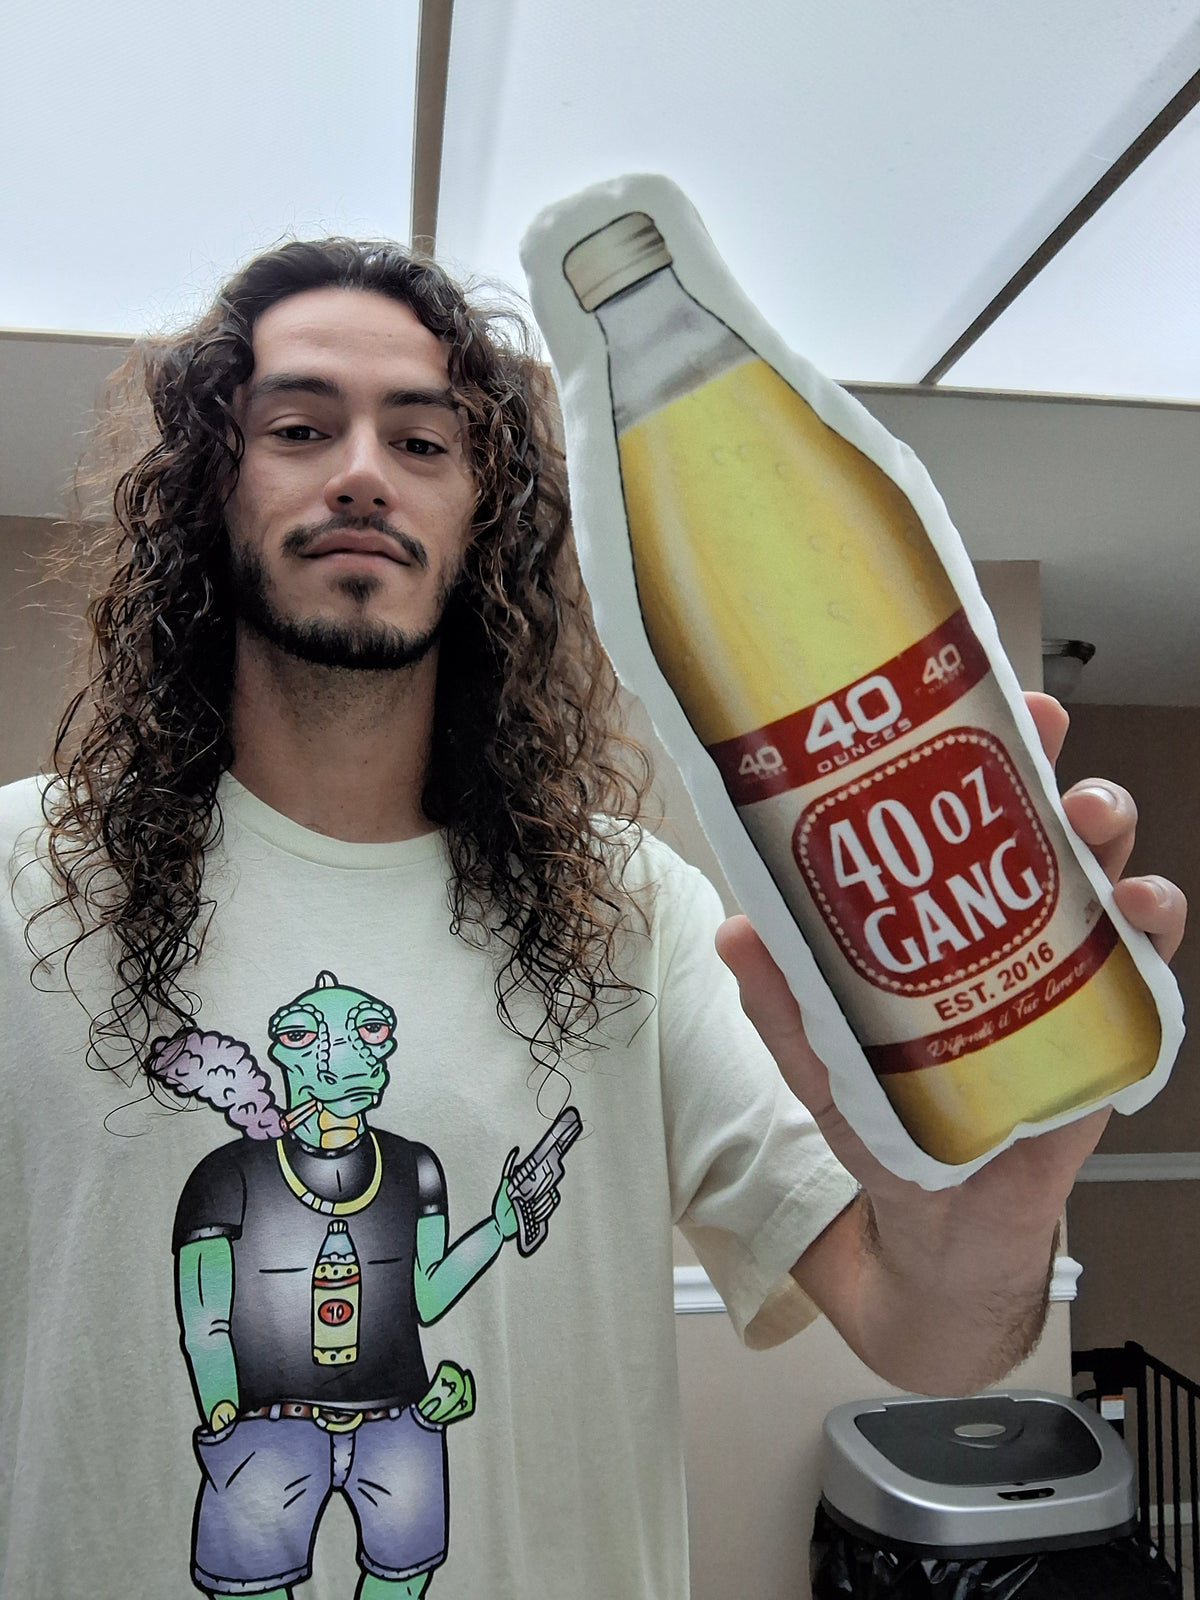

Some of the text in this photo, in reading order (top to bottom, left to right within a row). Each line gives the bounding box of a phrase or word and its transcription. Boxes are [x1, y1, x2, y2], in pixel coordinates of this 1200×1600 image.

[922, 643, 962, 685] 40
[805, 675, 902, 754] 40
[817, 718, 913, 774] OUNCES
[738, 745, 783, 777] 40
[829, 765, 1004, 903] 40 OZ
[863, 836, 1045, 974] GANG
[934, 942, 1055, 1022] EST. 2016
[326, 1304, 345, 1321] 40
